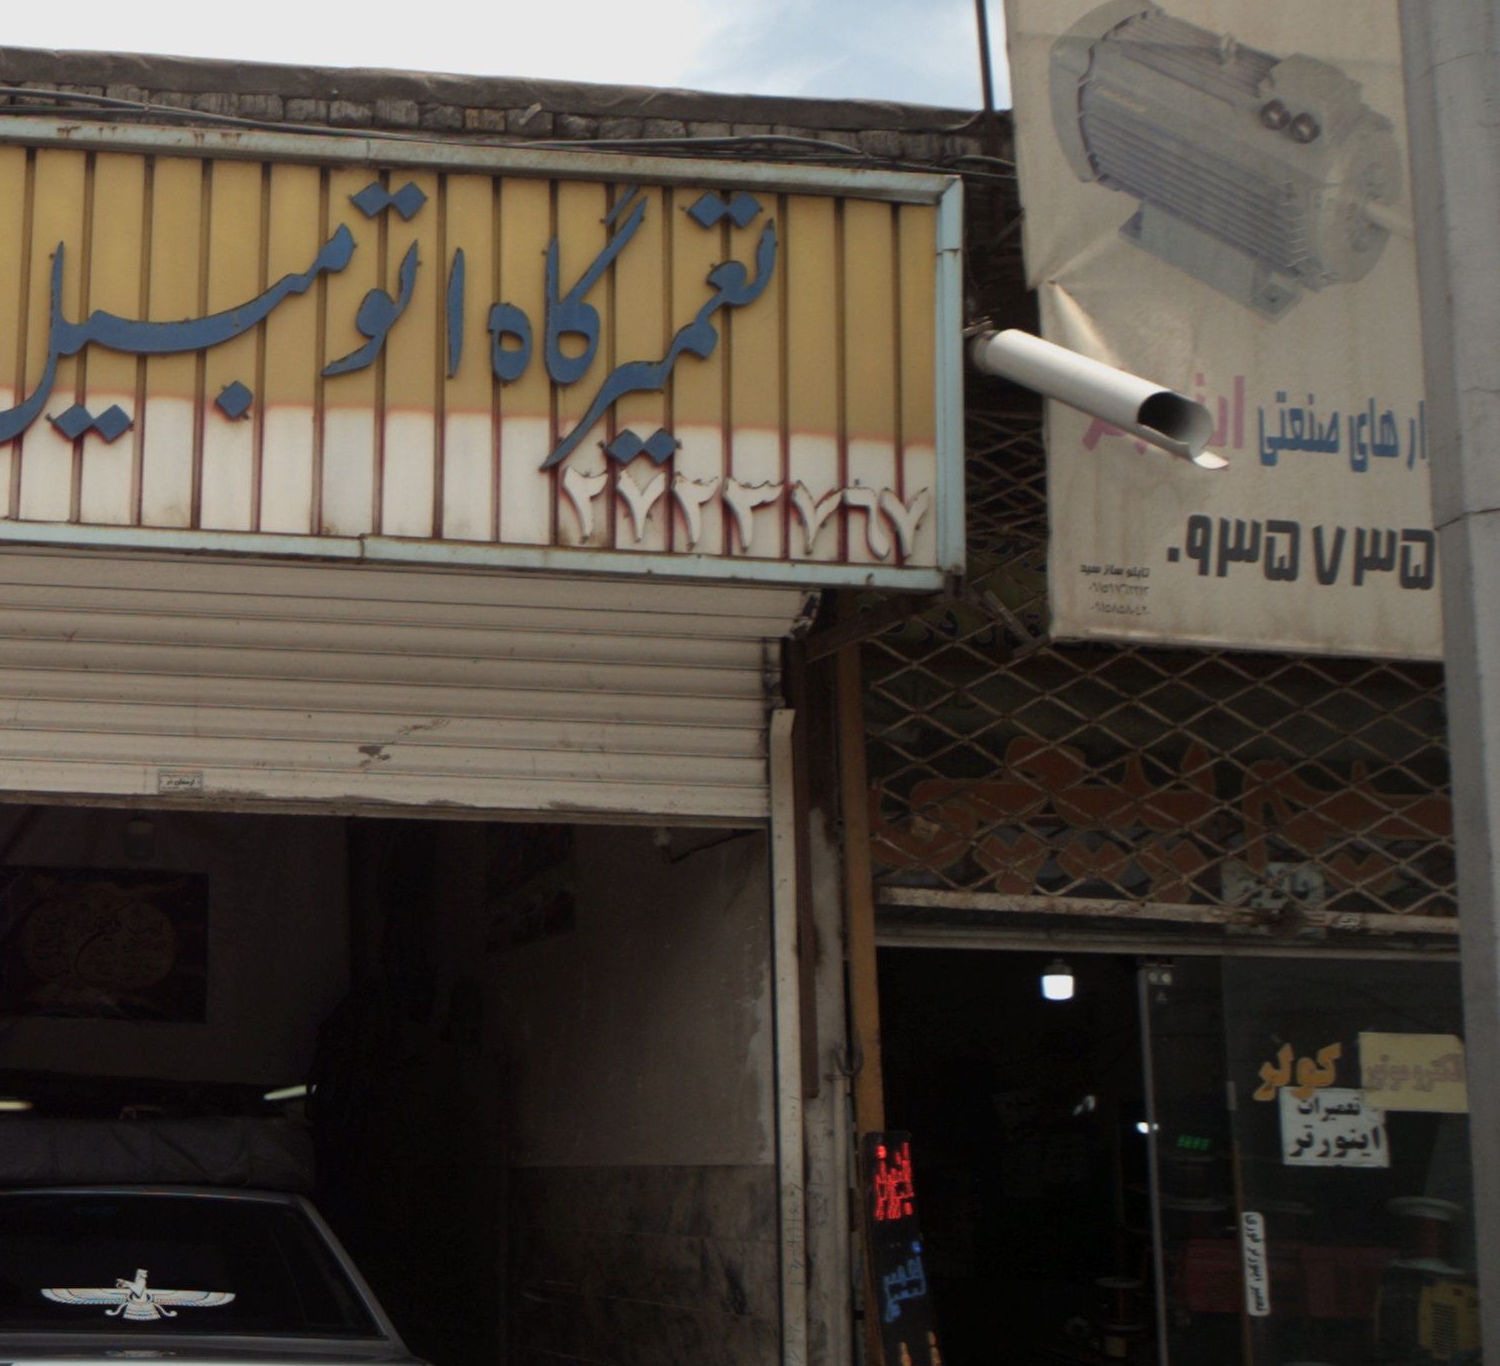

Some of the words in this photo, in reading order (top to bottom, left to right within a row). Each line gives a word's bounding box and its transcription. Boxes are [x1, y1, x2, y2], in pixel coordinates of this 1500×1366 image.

[1257, 390, 1341, 467] صنعتی
[1252, 1041, 1343, 1102] کولر
[1297, 1095, 1361, 1122] تعمیرات
[1289, 1123, 1381, 1158] اینورتر
